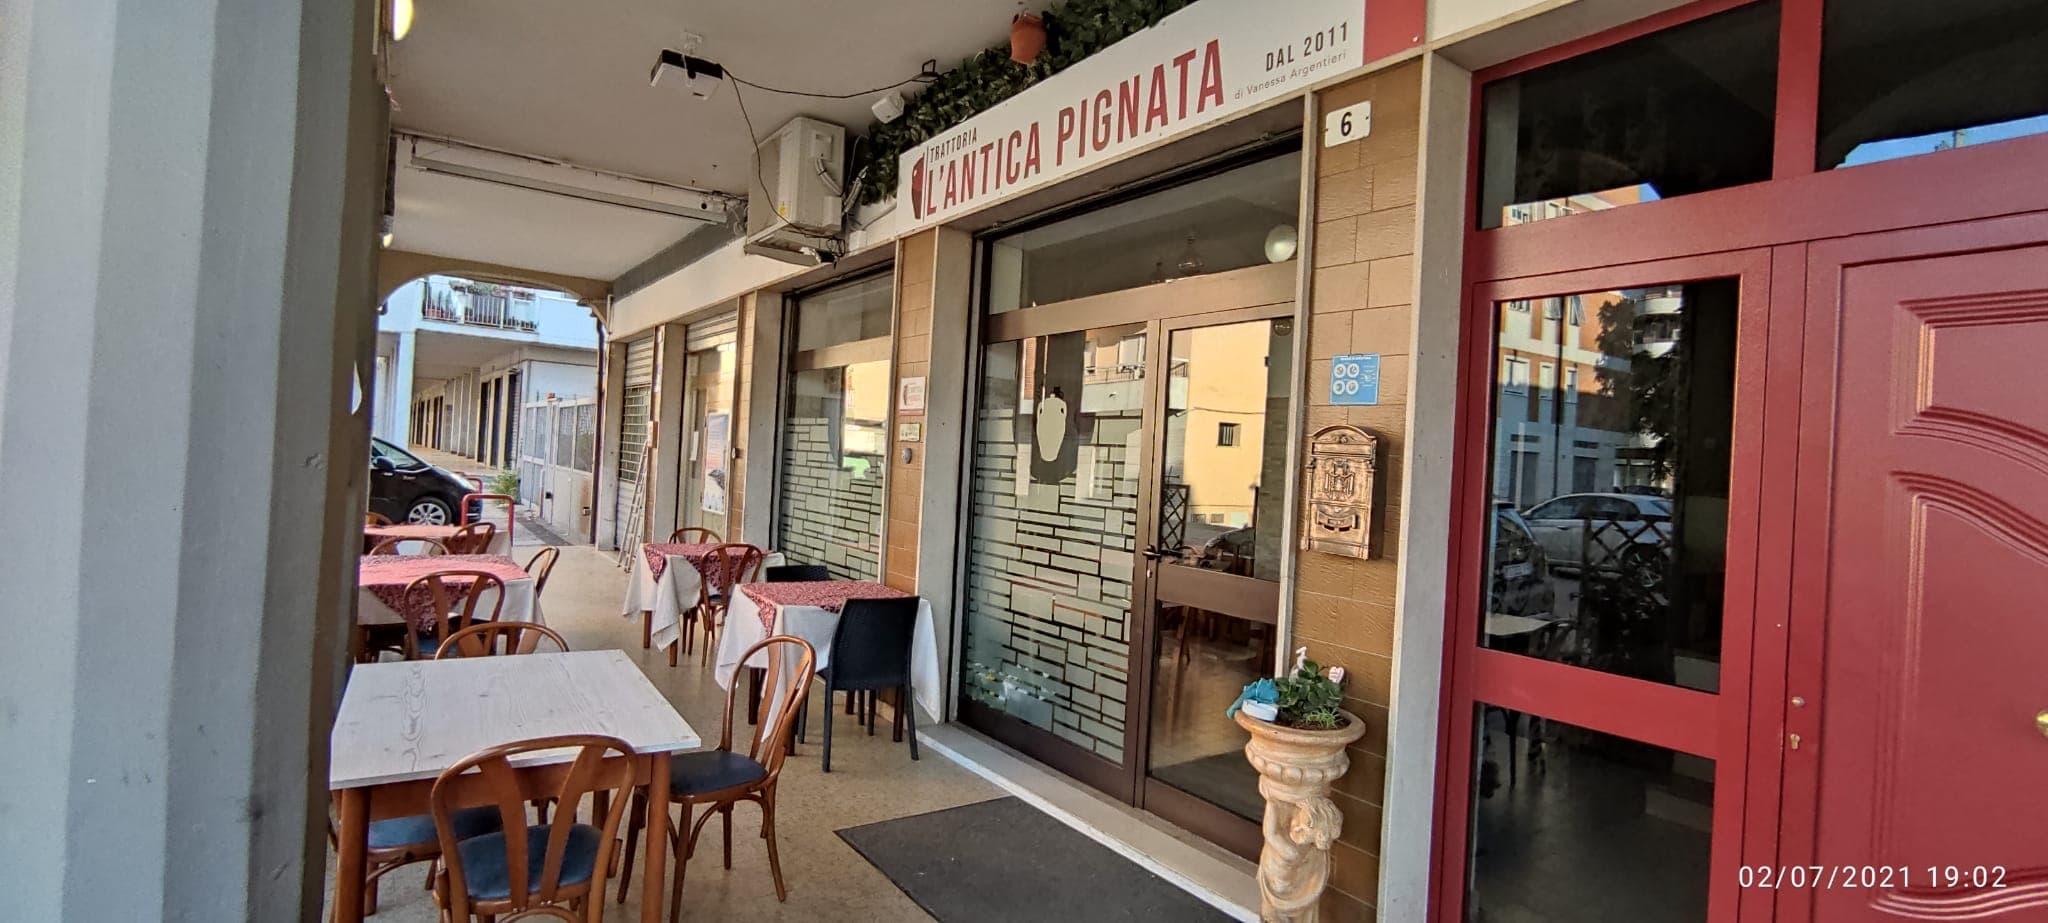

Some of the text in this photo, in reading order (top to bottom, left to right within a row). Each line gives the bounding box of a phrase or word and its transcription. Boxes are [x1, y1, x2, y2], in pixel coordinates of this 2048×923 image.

[1265, 21, 1348, 73] DAL 2011
[1234, 50, 1347, 100] di Vanessa Argentieri
[926, 38, 1225, 217] L'ANTICA PIGNATA
[930, 127, 977, 163] TRATTORIA
[1340, 111, 1353, 137] 6
